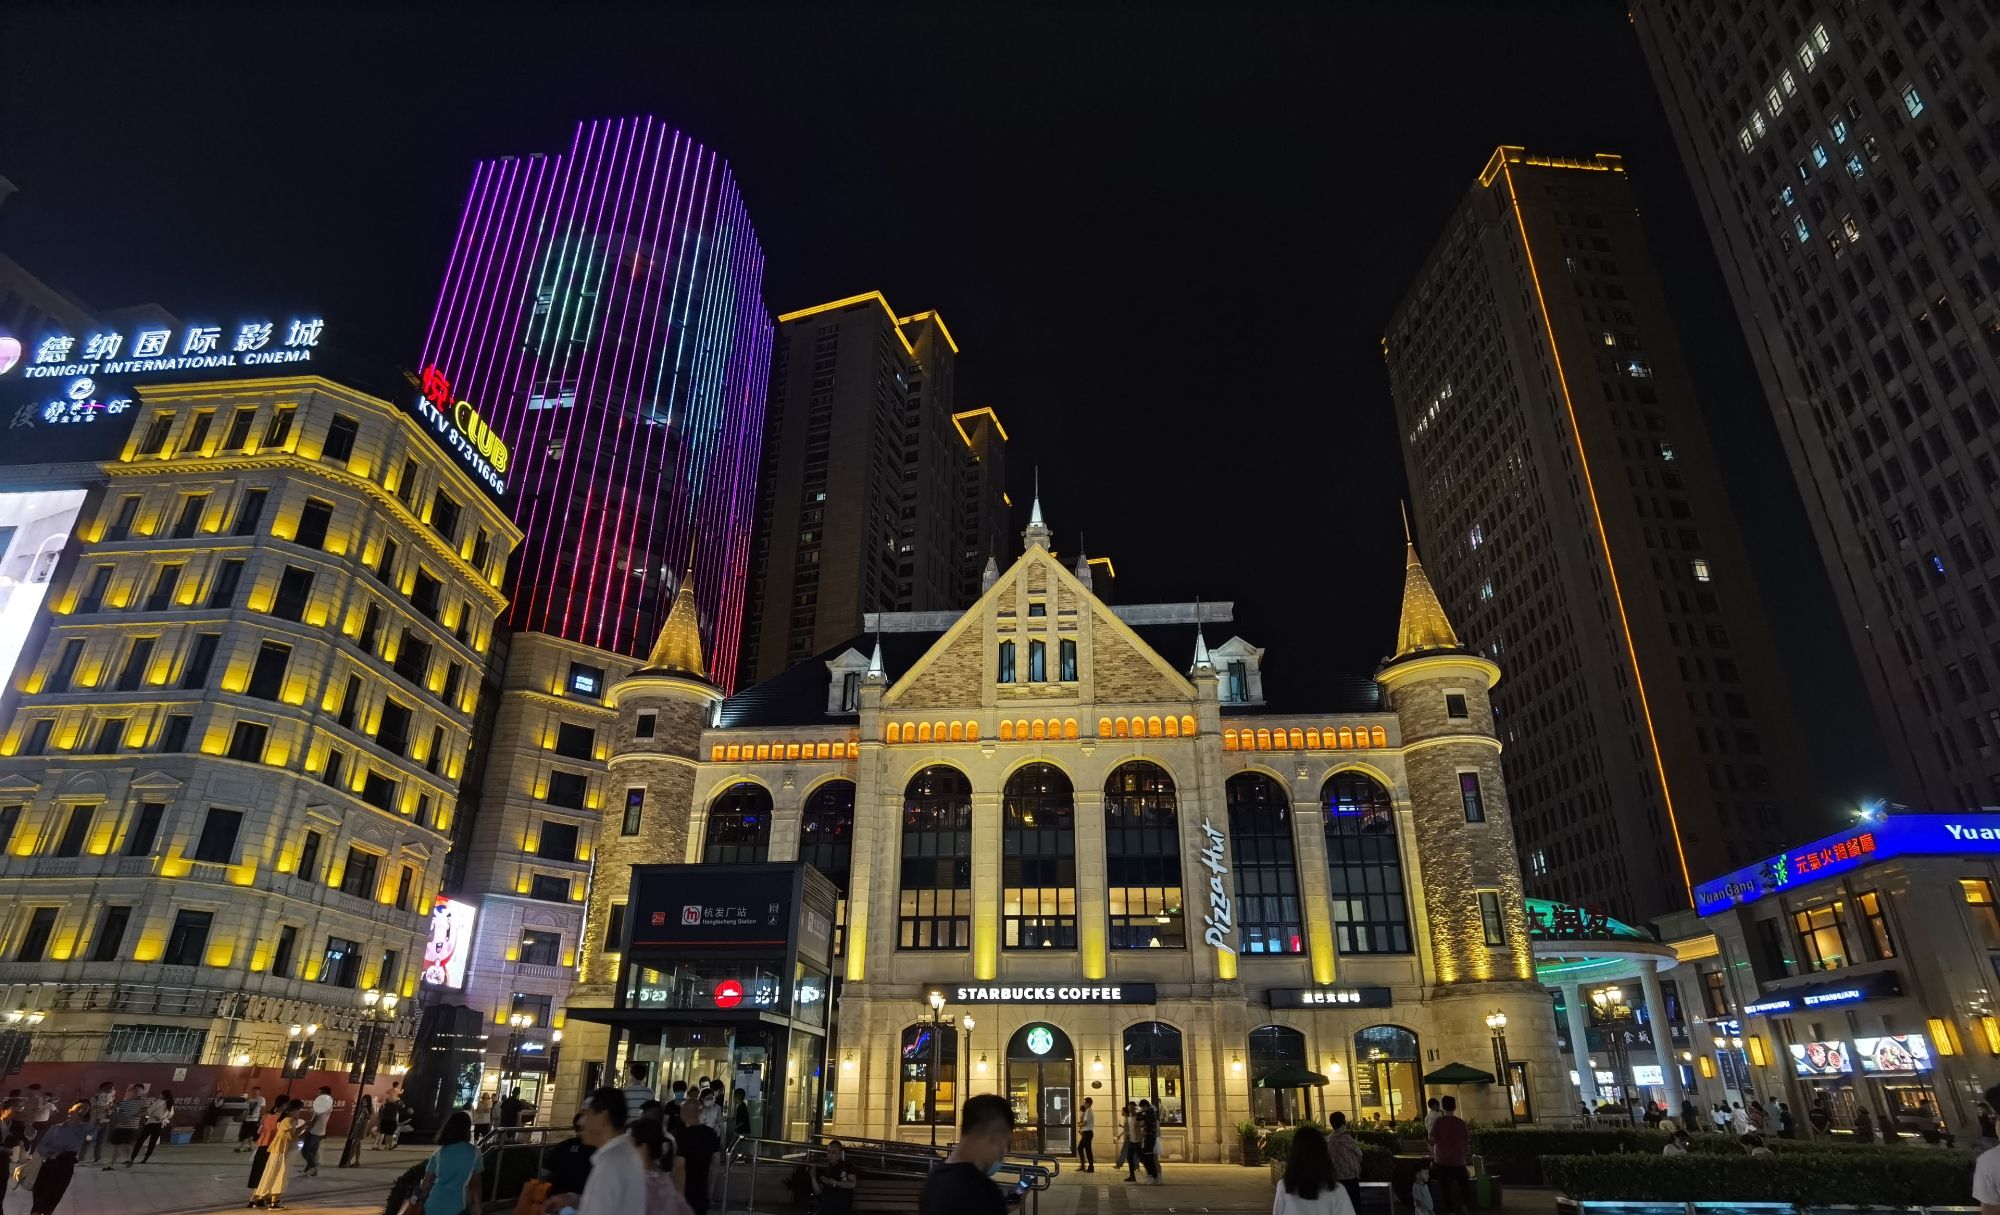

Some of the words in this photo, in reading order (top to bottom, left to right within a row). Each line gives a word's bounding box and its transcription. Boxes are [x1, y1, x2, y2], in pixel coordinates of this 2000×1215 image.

[35, 319, 324, 363] 德纳国际影城
[25, 363, 100, 378] TONIGHT
[104, 354, 237, 373] INTERNATIONAL
[244, 350, 311, 365] CINEMA
[107, 400, 132, 413] 6F
[418, 395, 449, 433] KTV
[448, 428, 504, 495] 87311666
[455, 400, 508, 473] CLUB
[1201, 817, 1228, 874] Hut
[703, 906, 748, 918] 杭发厂站
[1205, 875, 1236, 954] Pizza
[957, 987, 1055, 1000] STARBUCKS
[1058, 987, 1122, 1000] COFFEE
